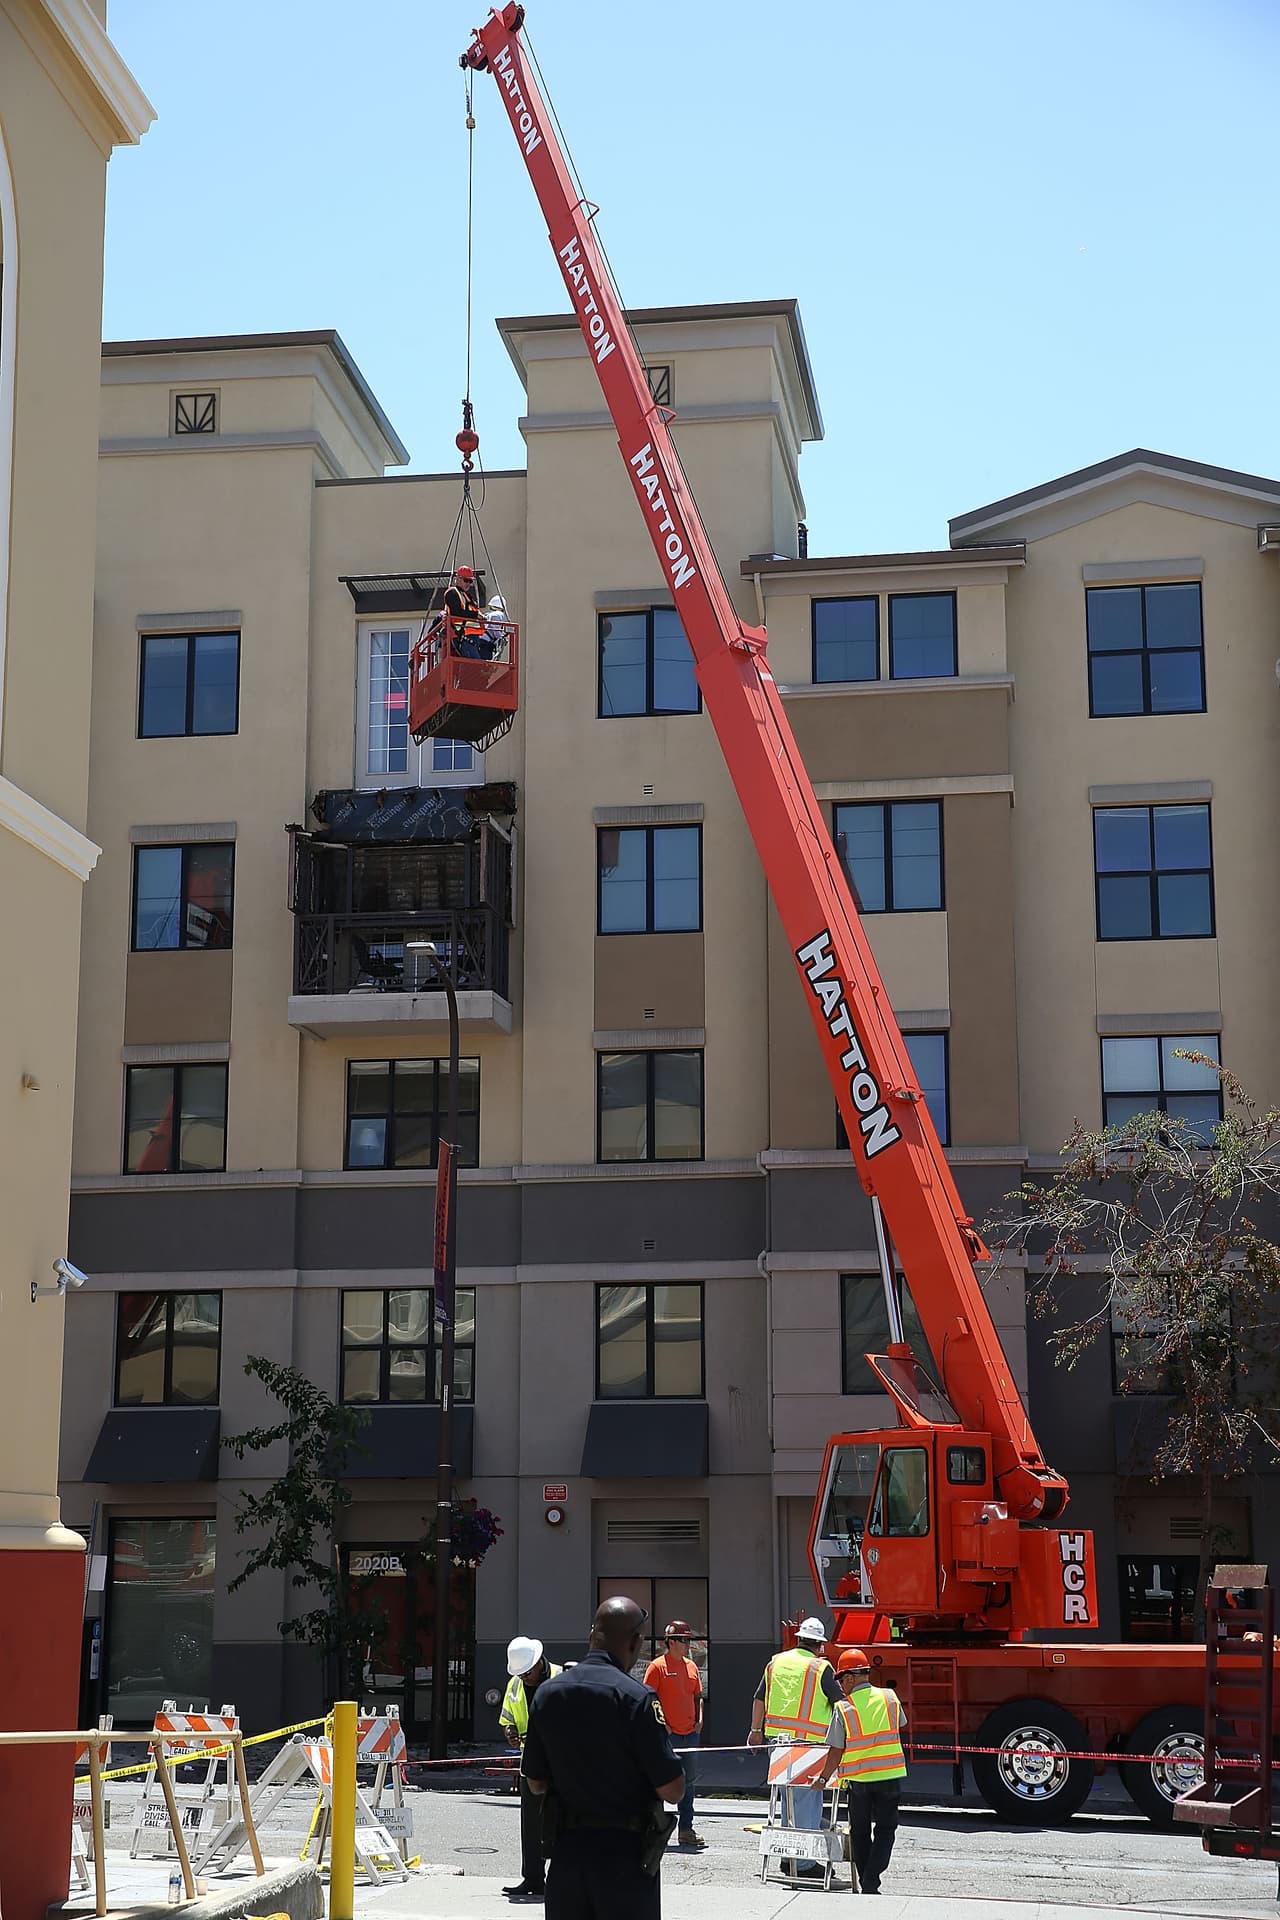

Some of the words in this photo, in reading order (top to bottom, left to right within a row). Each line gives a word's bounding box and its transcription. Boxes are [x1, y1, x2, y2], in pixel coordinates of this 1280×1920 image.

[493, 45, 542, 156] HATTON
[559, 235, 617, 365] HATTON
[630, 442, 696, 590] HATTON
[796, 929, 901, 1159] HATTON
[355, 1556, 400, 1570] 2020B
[1059, 1533, 1089, 1622] HCR
[144, 1812, 170, 1820] DIVISI
